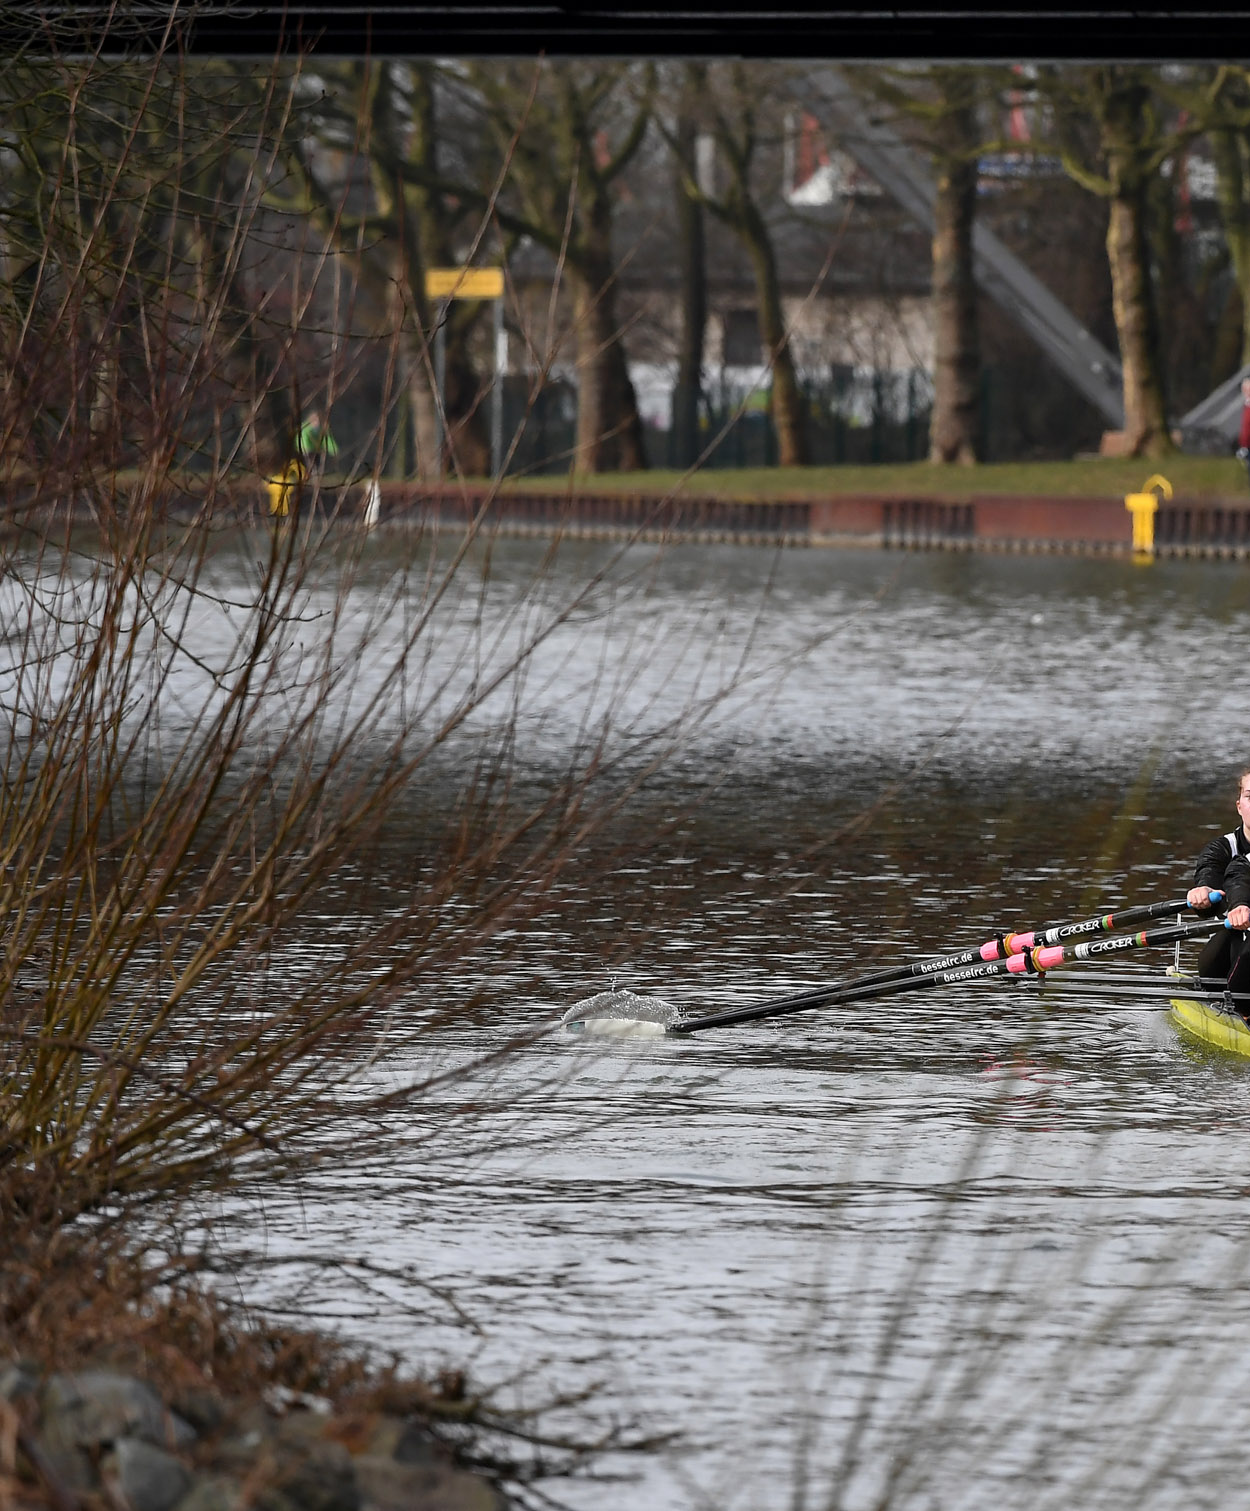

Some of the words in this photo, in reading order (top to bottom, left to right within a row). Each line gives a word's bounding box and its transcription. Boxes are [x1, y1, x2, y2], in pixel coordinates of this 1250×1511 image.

[1060, 920, 1100, 936] CROKER
[1091, 937, 1133, 952] CROKER
[920, 953, 973, 973] besselrc.de
[943, 965, 998, 982] besselrc.de
